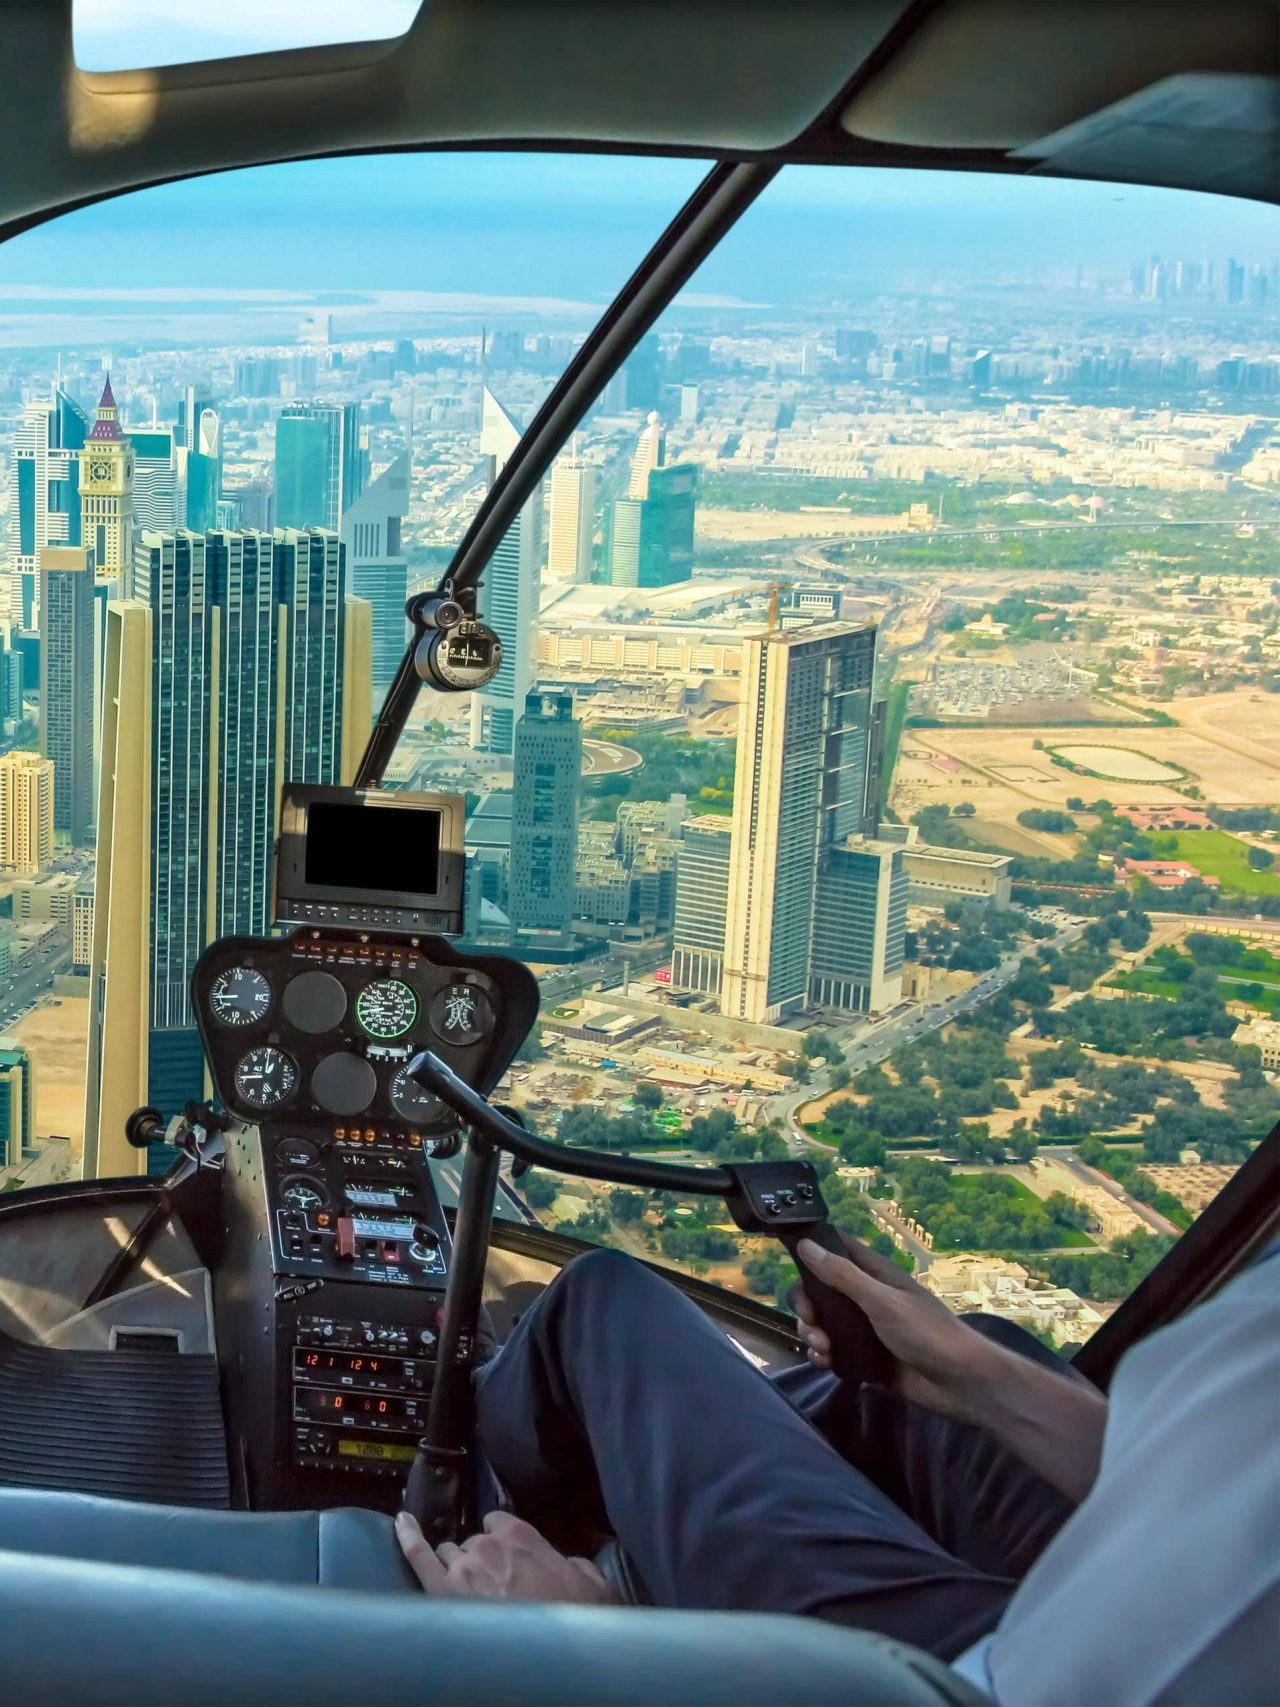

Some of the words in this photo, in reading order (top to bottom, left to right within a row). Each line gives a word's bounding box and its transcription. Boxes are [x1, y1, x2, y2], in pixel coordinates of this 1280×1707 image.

[306, 1354, 318, 1365] 12
[350, 1360, 362, 1370] 12
[370, 1361, 378, 1370] 4
[335, 1396, 342, 1408] 0
[380, 1401, 386, 1412] 0
